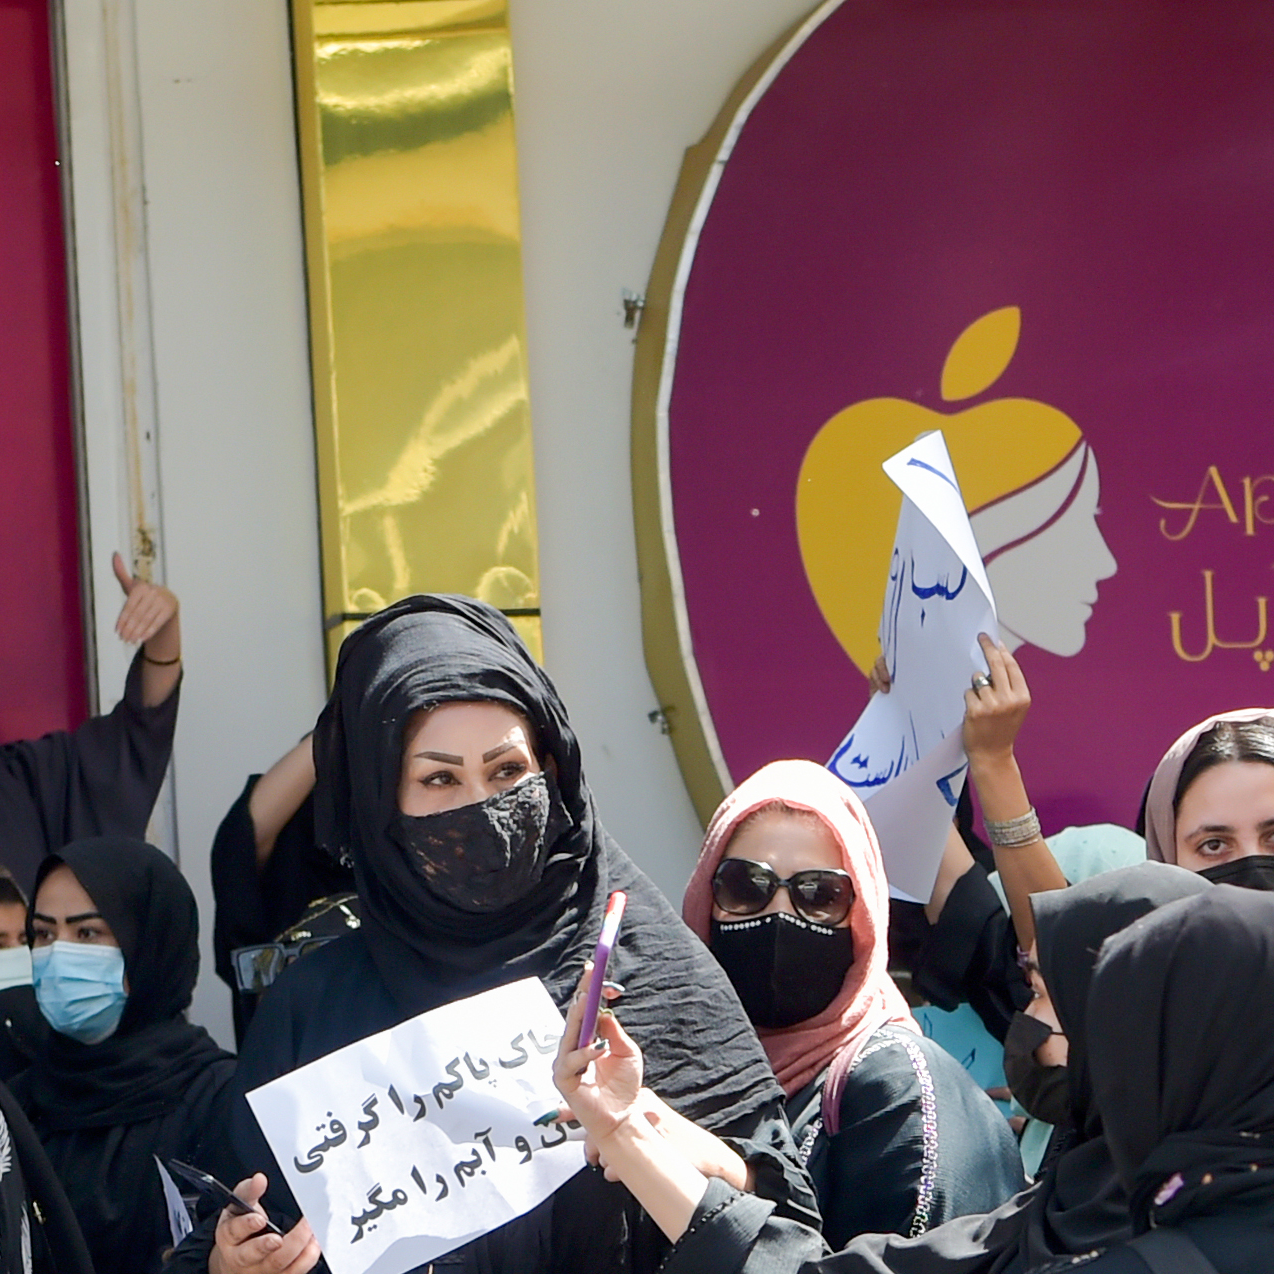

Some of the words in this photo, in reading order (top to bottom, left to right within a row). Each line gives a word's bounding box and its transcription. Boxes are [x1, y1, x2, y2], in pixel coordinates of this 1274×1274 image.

[388, 1083, 427, 1122] را
[432, 1052, 498, 1110] پاکم
[293, 1092, 380, 1174] گرفتی
[453, 1126, 496, 1188] آبم
[514, 1135, 532, 1165] و
[410, 1164, 449, 1202] را
[350, 1181, 408, 1245] مگیر
